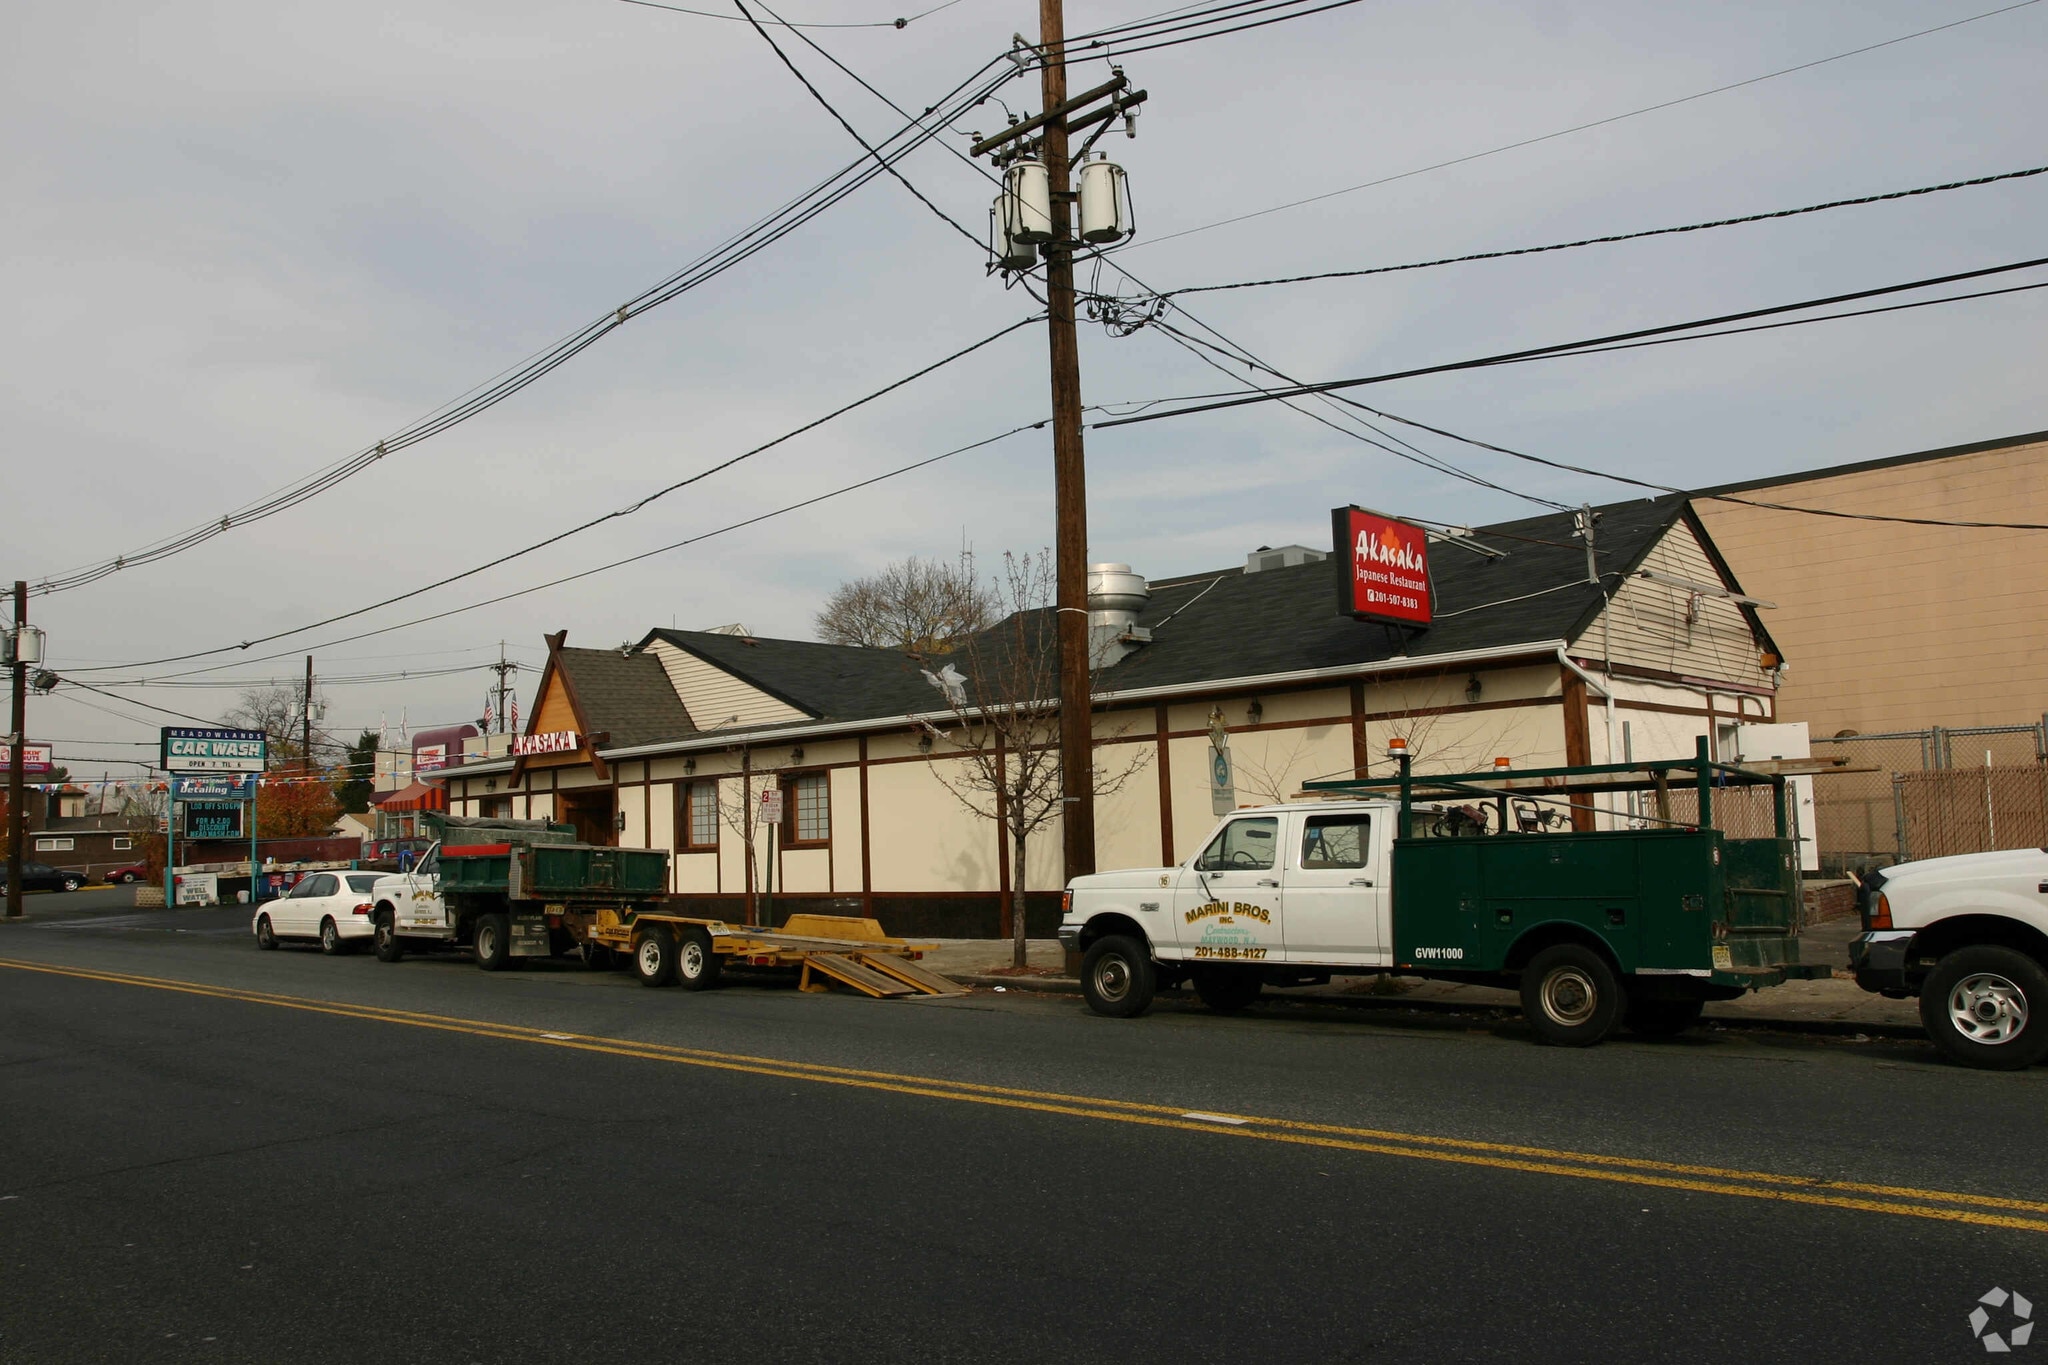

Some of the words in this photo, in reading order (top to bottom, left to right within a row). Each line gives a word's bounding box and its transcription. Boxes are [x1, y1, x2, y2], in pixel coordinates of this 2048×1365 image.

[1355, 530, 1424, 574] Akasaka
[1356, 564, 1389, 584] Japanese
[1390, 572, 1426, 592] Restaurant
[1376, 591, 1418, 609] 201-507-8383
[171, 730, 261, 739] MEADOWLANDS
[171, 740, 209, 756] CAR
[212, 742, 261, 756] WASH
[513, 732, 571, 755] AKASAKA
[179, 786, 228, 796] Detailing
[196, 817, 209, 825] FOR
[210, 817, 216, 825] A
[1184, 901, 1229, 925] MARINI
[1233, 901, 1272, 926] BROS.
[1219, 916, 1234, 925] INC.
[1195, 946, 1268, 960] 201-488-4127
[1415, 948, 1463, 959] GVW11000
